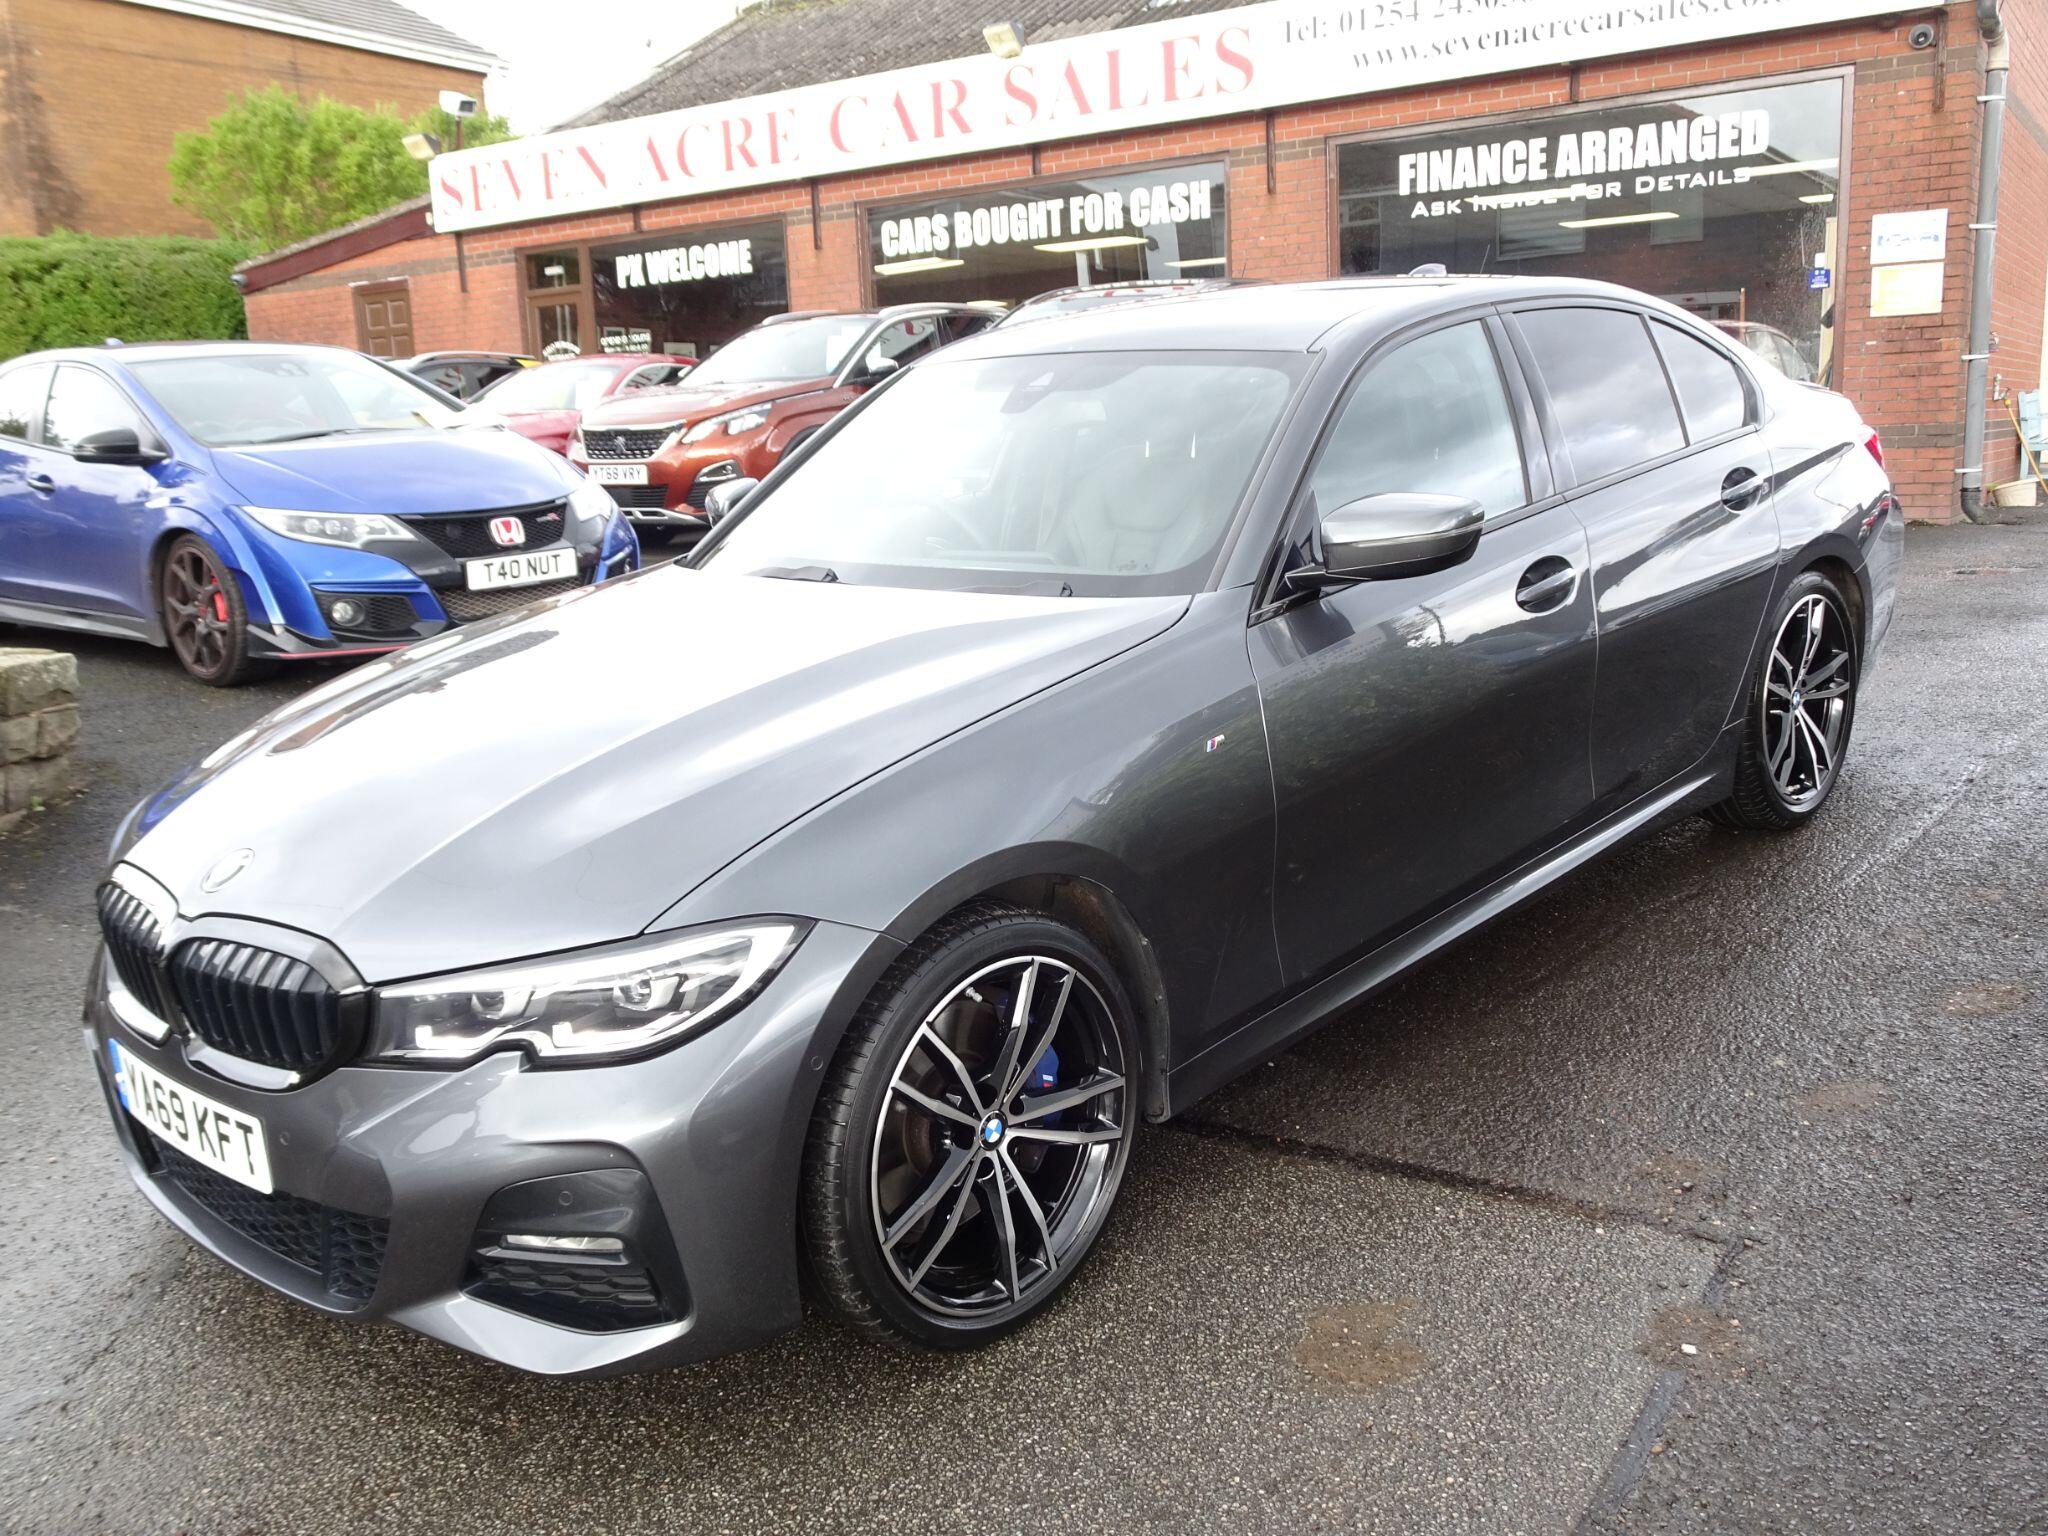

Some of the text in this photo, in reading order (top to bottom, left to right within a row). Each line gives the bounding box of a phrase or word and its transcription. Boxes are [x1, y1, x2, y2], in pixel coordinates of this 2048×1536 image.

[1281, 16, 1328, 43] Tel:
[1339, 0, 1419, 34] 01254
[439, 27, 1255, 217] SEVEN ACRE CAR SALES
[1399, 109, 1770, 197] FINANCE ARRANGED
[881, 179, 1212, 257] CARS BOUGHT FOR CASH
[1410, 199, 1462, 219] ASK
[1570, 181, 1622, 201] FOR
[1635, 166, 1752, 194] DETAILS
[615, 239, 754, 289] PX WELCOME
[484, 553, 561, 583] T40 NUT
[124, 1058, 256, 1176] YA69 KFT
